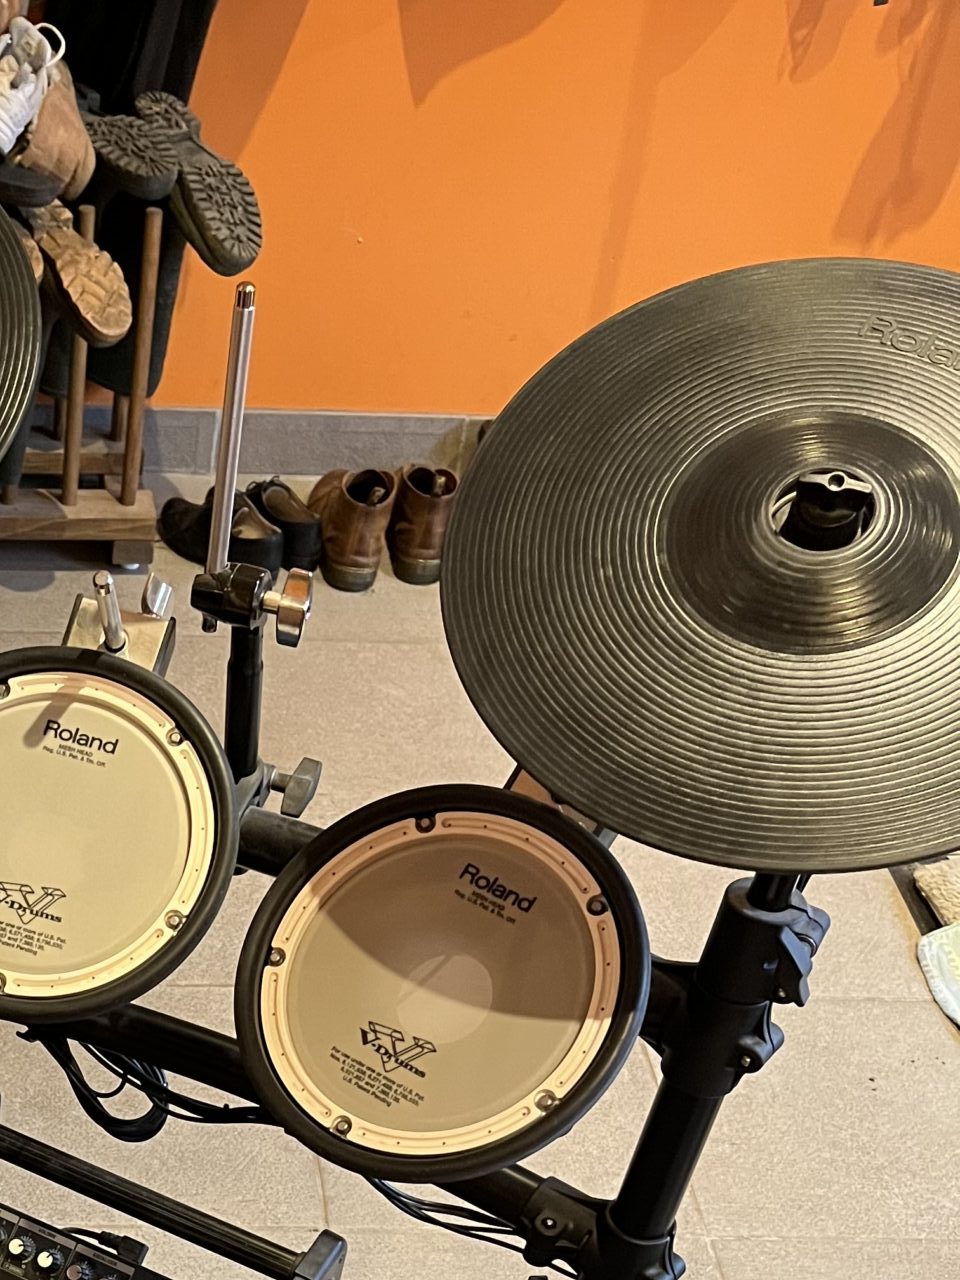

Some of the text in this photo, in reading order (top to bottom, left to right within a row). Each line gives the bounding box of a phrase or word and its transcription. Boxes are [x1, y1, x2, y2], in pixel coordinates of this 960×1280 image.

[858, 314, 960, 371] Rola
[43, 719, 119, 755] Roland
[459, 862, 538, 913] Roland
[359, 1027, 426, 1078] V-Drums
